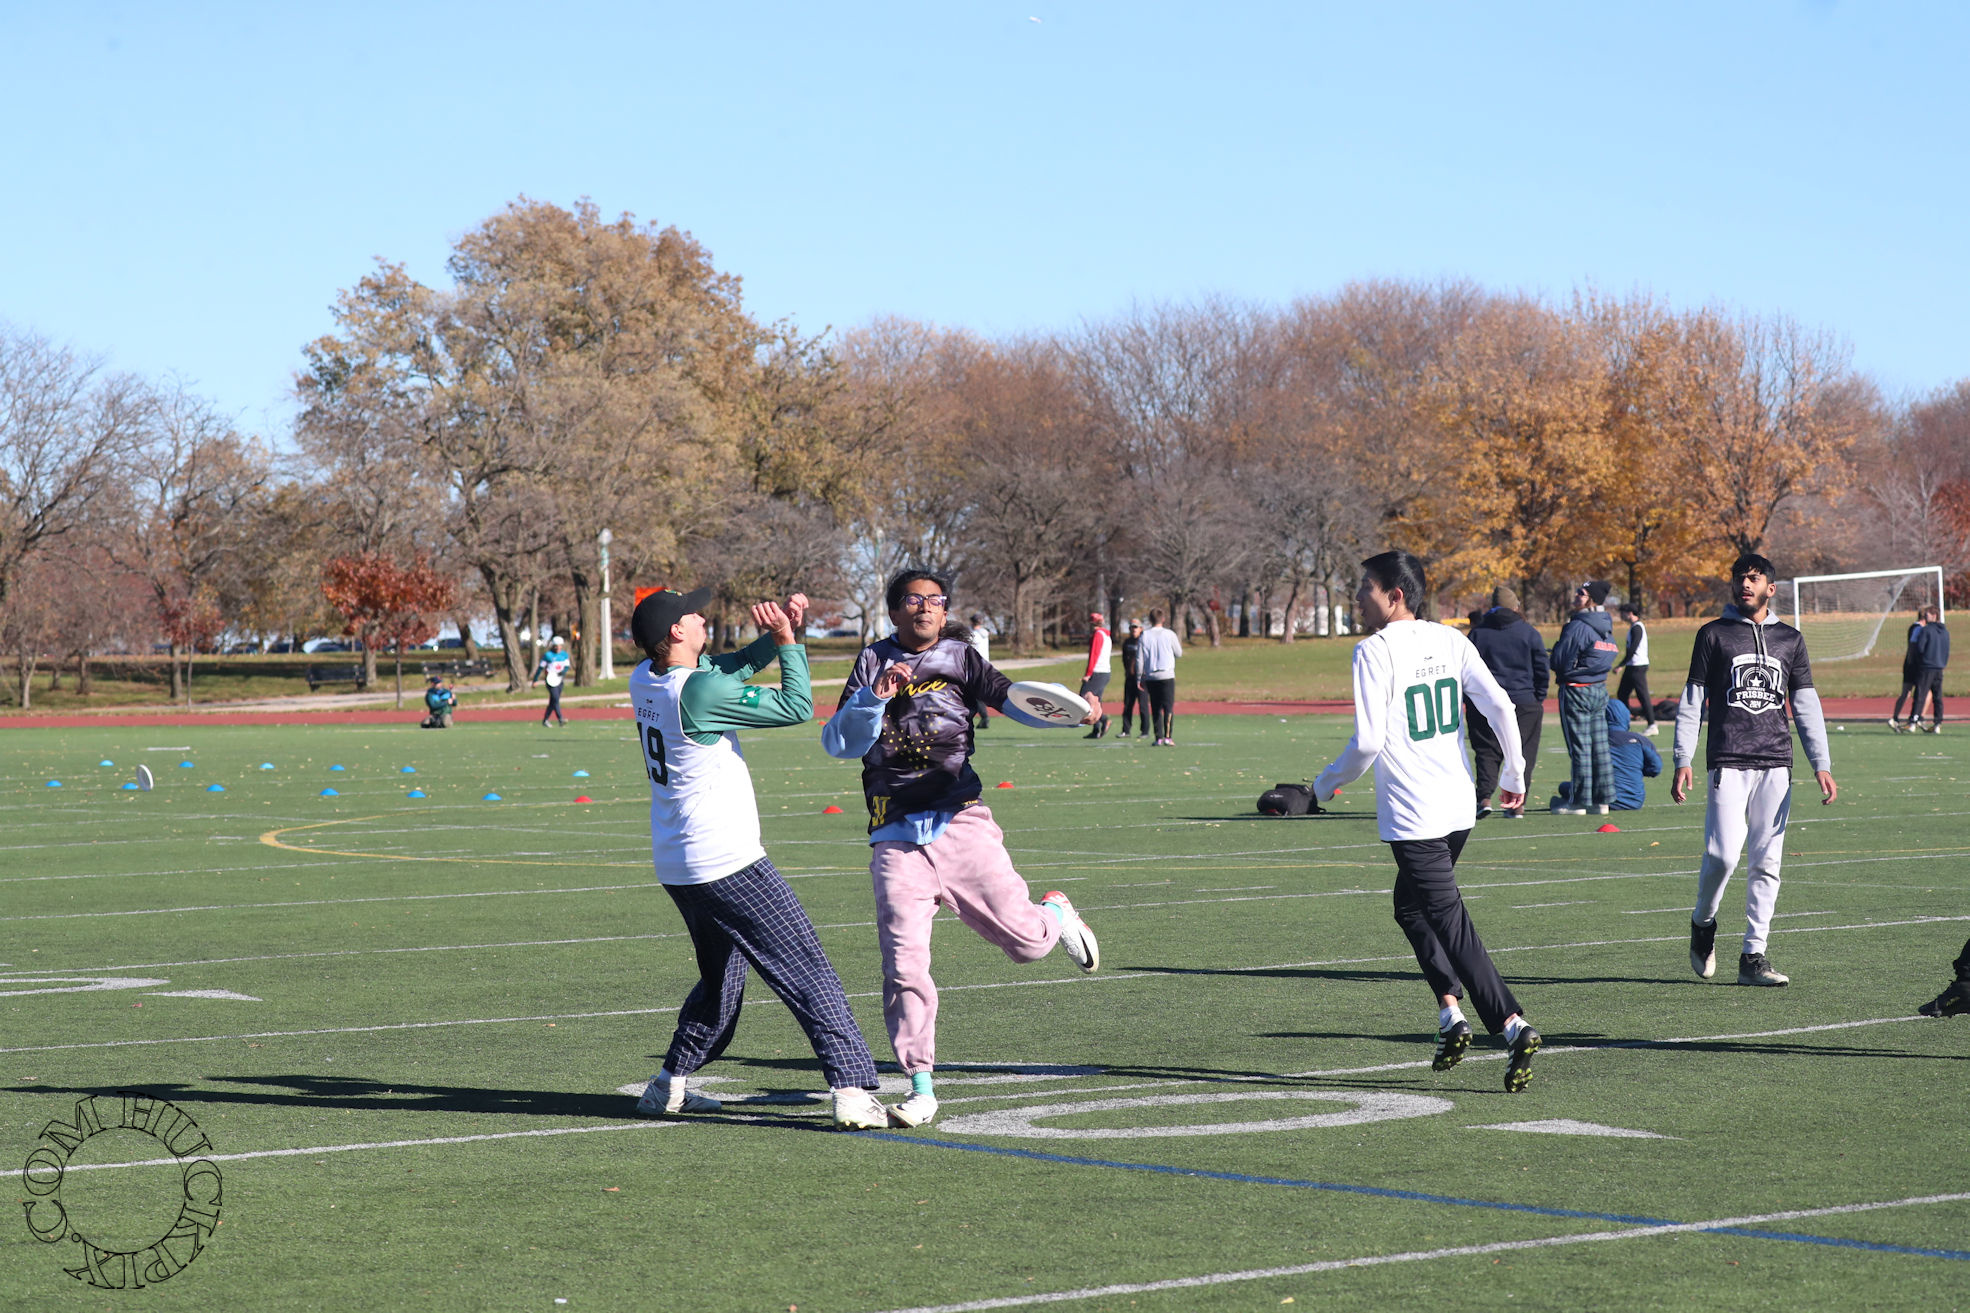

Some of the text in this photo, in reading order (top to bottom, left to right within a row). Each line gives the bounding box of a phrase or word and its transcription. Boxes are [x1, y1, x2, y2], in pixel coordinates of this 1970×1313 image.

[1415, 665, 1446, 678] EGRET
[1735, 690, 1776, 702] FRISBEE
[638, 707, 660, 723] EGRET
[1404, 677, 1459, 742] 00
[637, 722, 668, 787] 19
